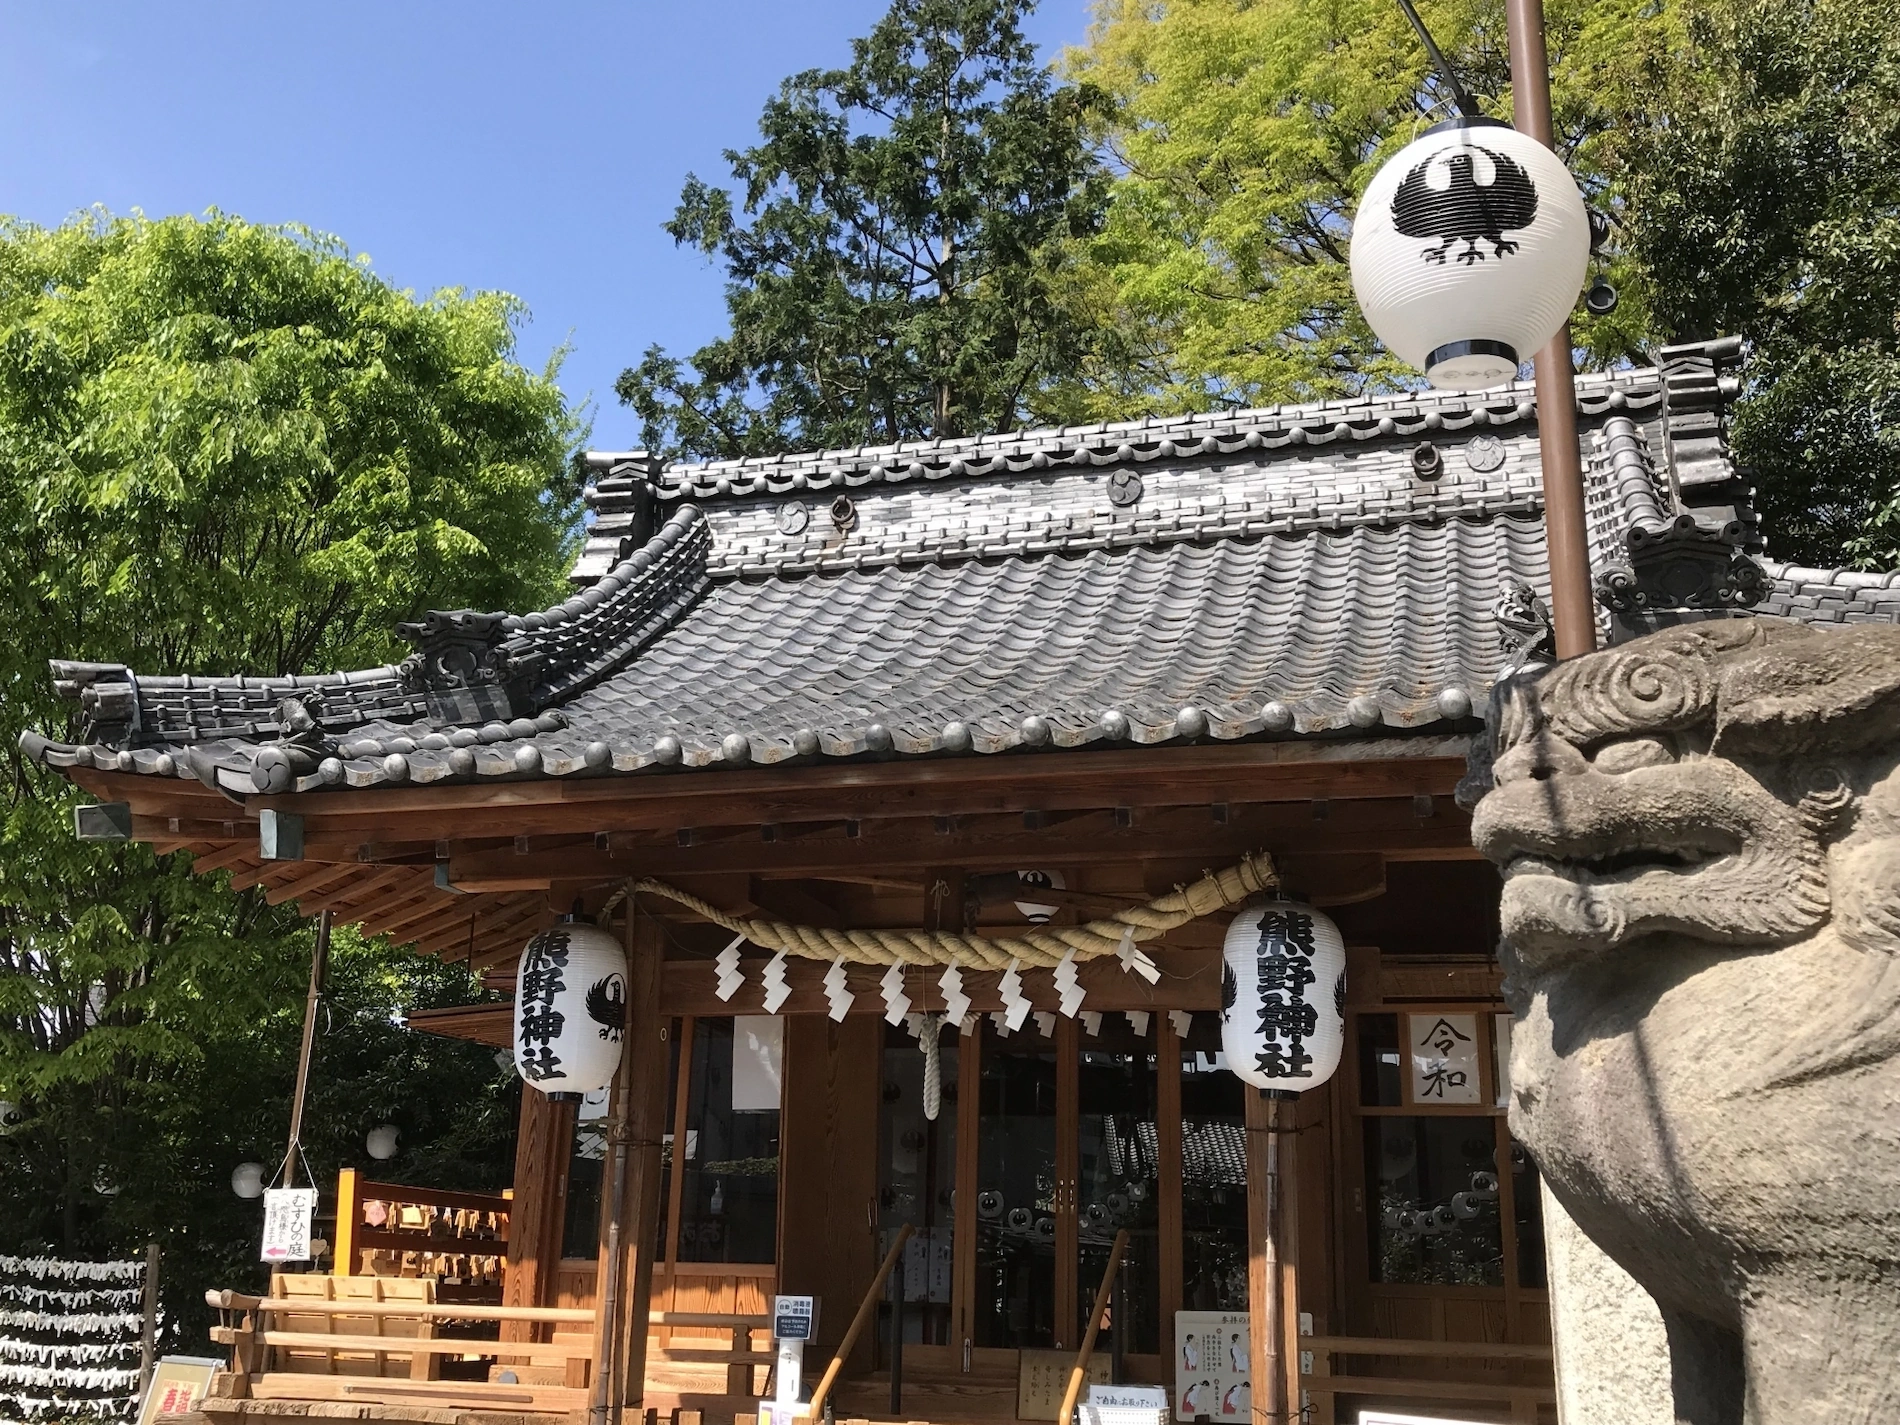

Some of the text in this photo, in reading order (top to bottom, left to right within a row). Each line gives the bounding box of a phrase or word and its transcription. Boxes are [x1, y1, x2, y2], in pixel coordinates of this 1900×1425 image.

[519, 930, 571, 1082] 熊野神社
[1254, 911, 1318, 1078] 熊野神社
[1420, 1018, 1471, 1098] 令和
[287, 1194, 306, 1257] むすひの庭
[792, 1300, 810, 1308] 消毒液
